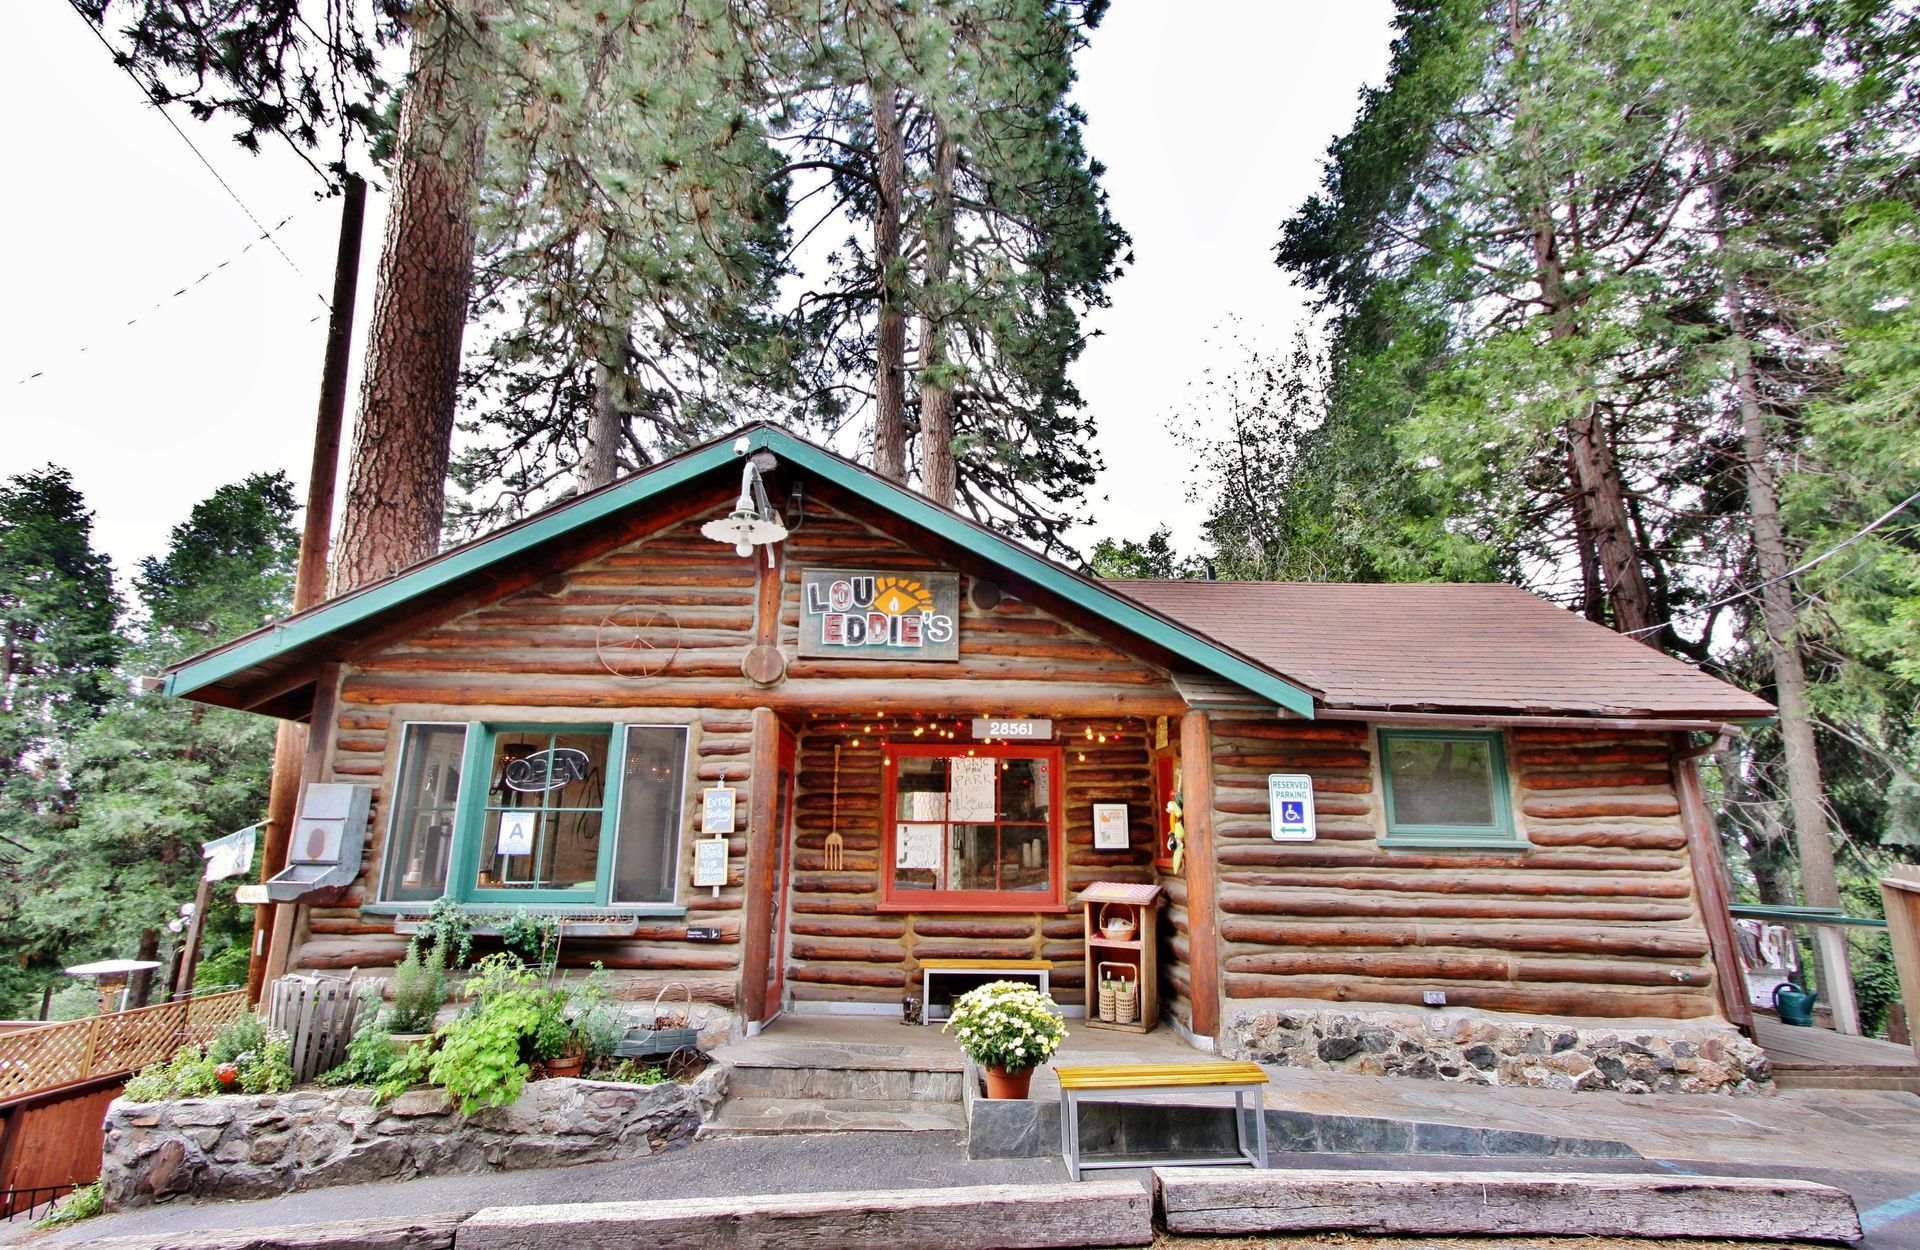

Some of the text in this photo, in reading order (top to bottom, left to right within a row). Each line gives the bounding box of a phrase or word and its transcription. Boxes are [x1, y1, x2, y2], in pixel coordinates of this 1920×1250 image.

[807, 576, 875, 614] LOU
[822, 611, 953, 647] EDDIE'S
[990, 722, 1033, 735] 28561
[507, 757, 584, 783] OPEN
[954, 773, 992, 786] PARK
[1273, 781, 1308, 789] RESERVED
[1276, 791, 1307, 799] PARKING
[509, 822, 524, 840] A
